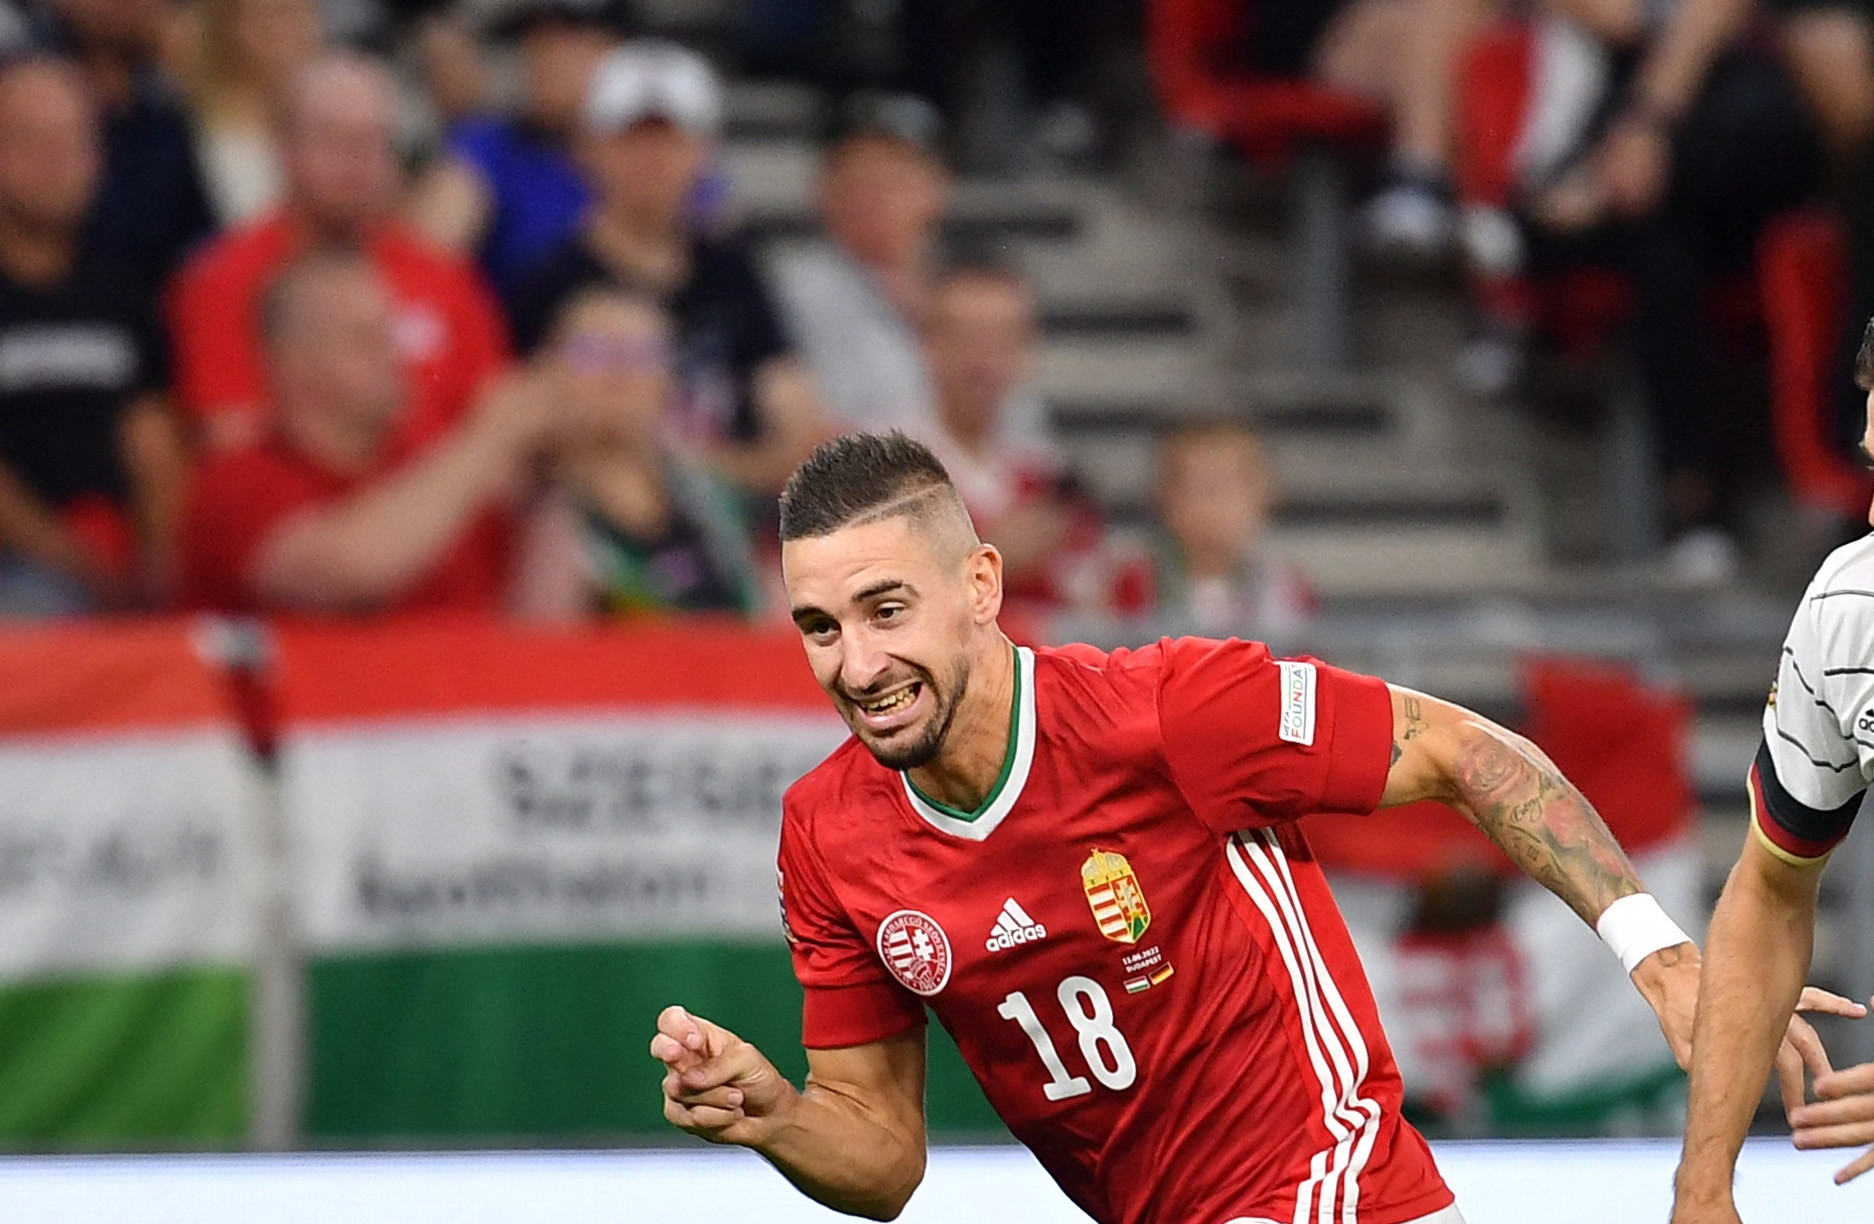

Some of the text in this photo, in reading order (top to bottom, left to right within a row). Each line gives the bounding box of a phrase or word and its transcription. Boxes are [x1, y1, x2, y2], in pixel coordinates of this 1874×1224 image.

[1291, 664, 1304, 739] FOUNDA
[985, 923, 1047, 952] adidas
[997, 975, 1137, 1101] 18
